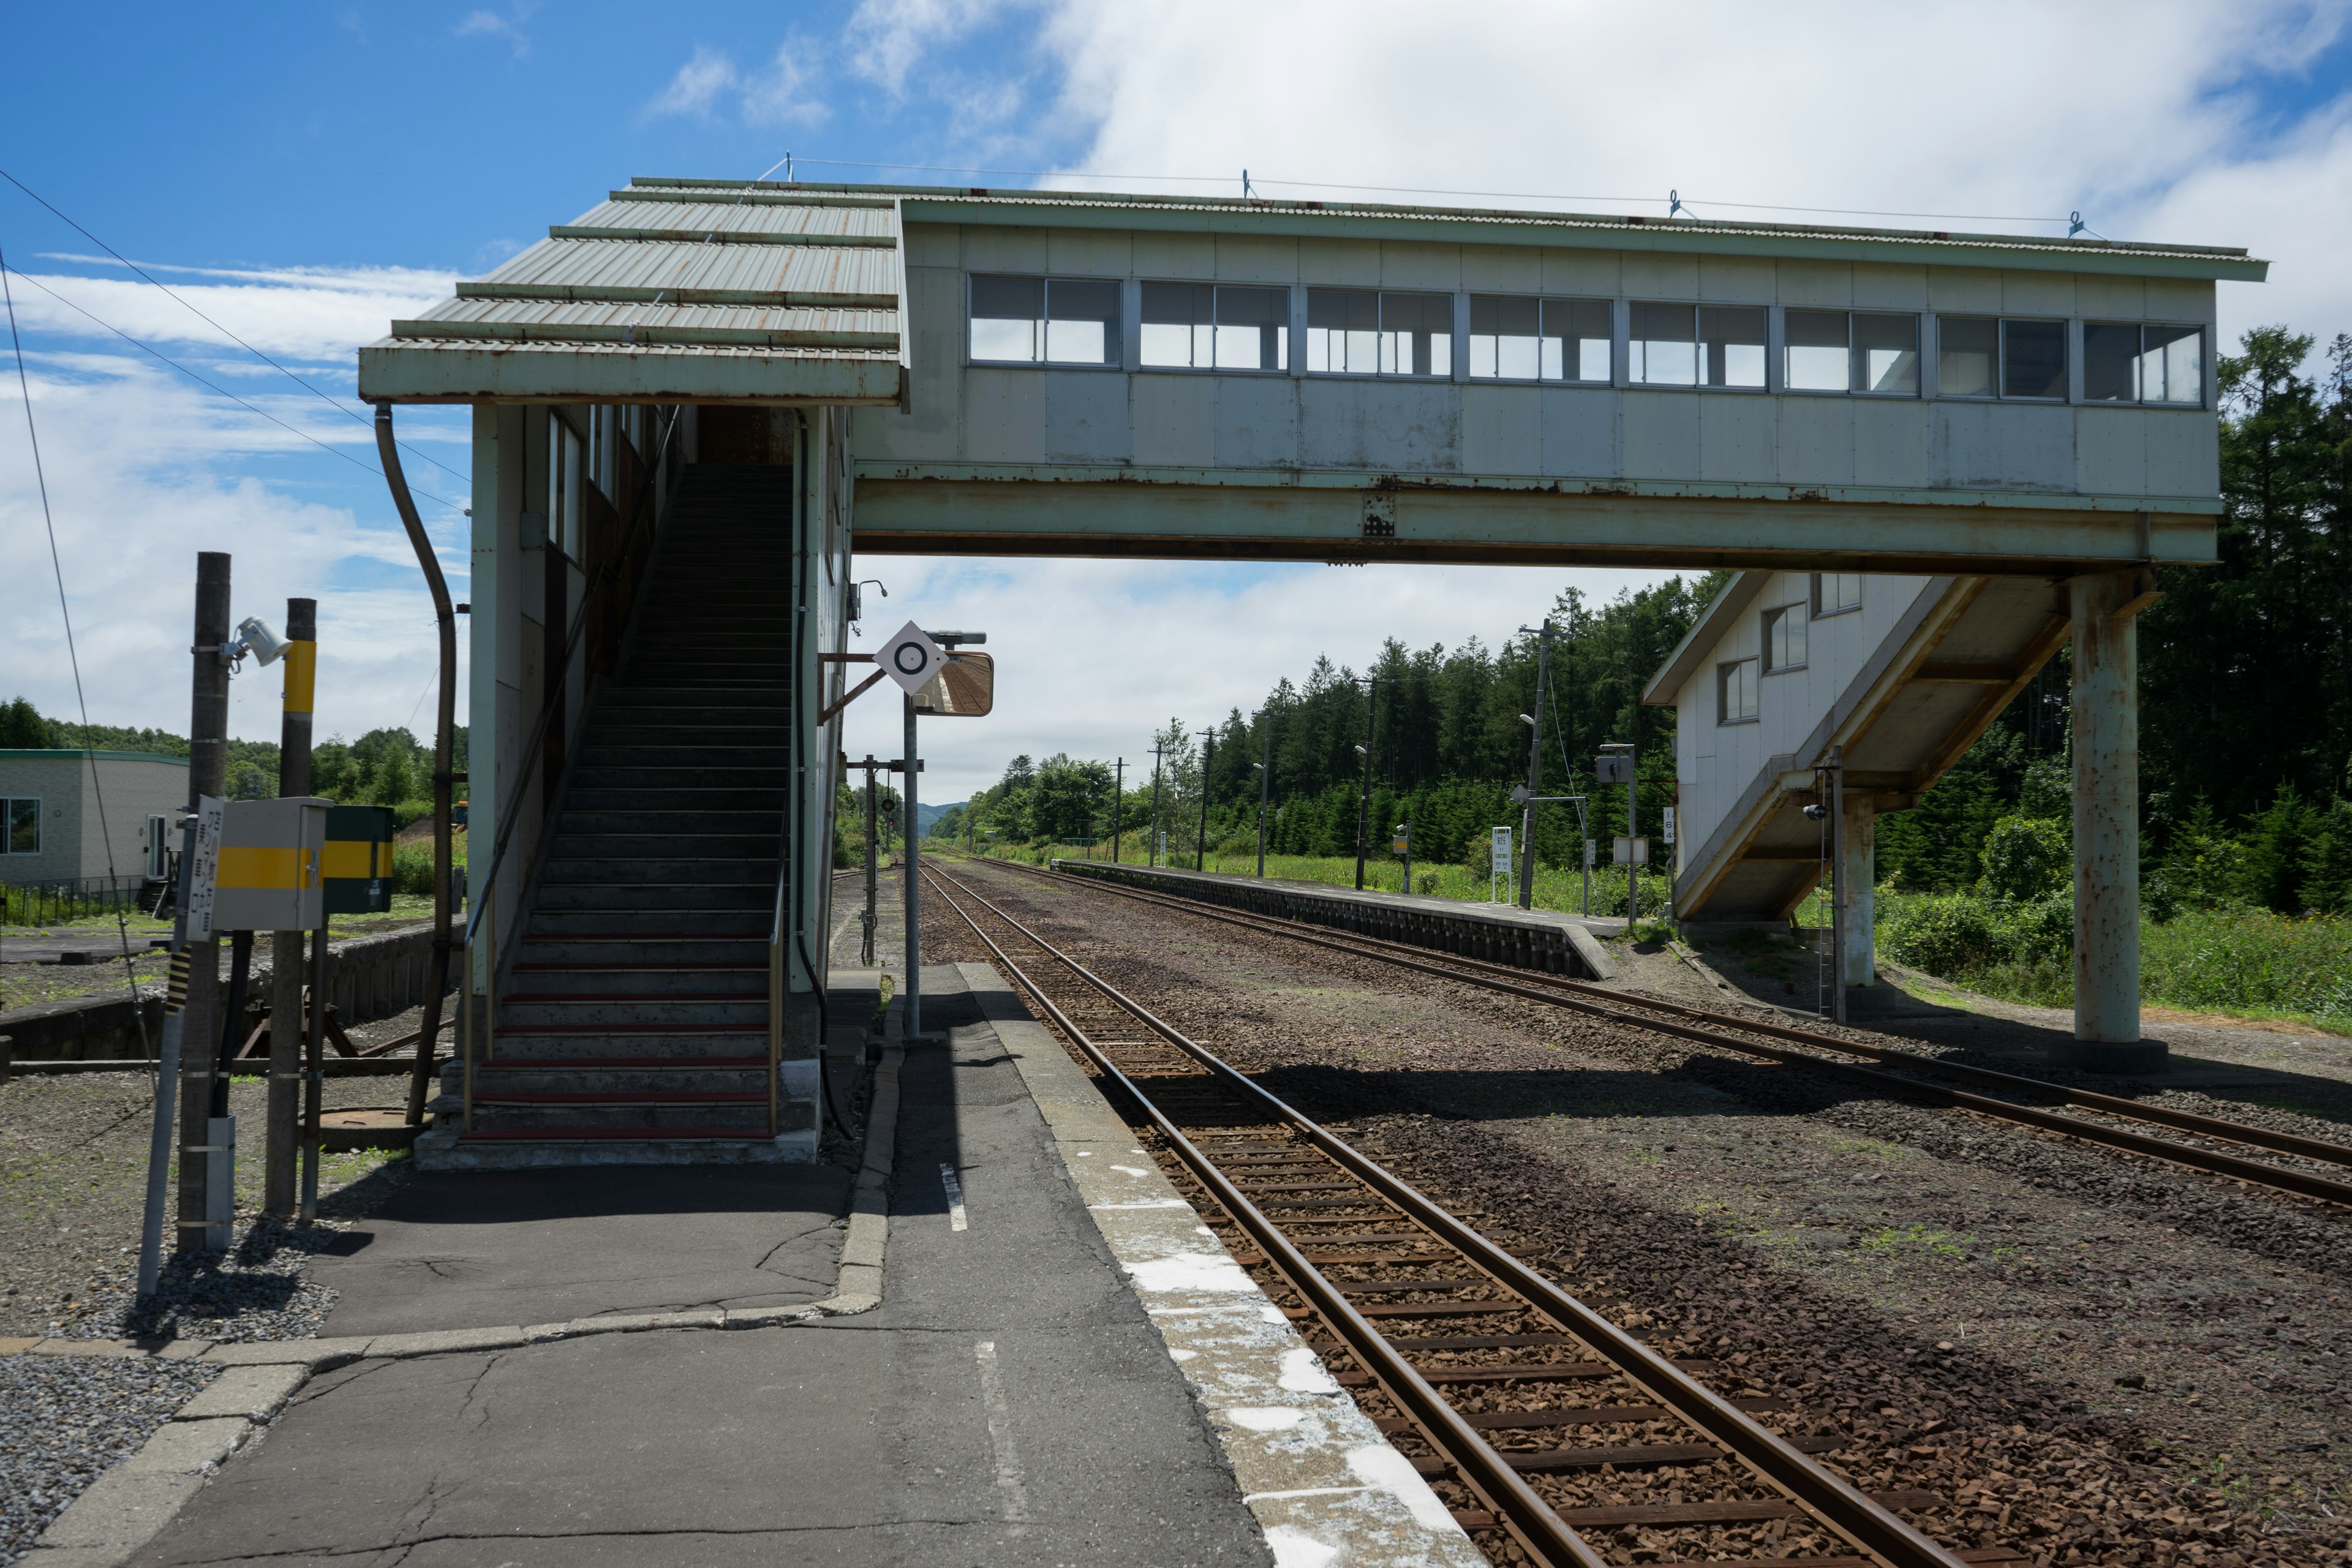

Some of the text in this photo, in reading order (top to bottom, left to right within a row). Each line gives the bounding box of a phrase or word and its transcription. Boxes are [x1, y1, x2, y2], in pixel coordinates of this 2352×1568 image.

[1497, 836, 1506, 845] あびら
[191, 824, 206, 914] 乗車口
